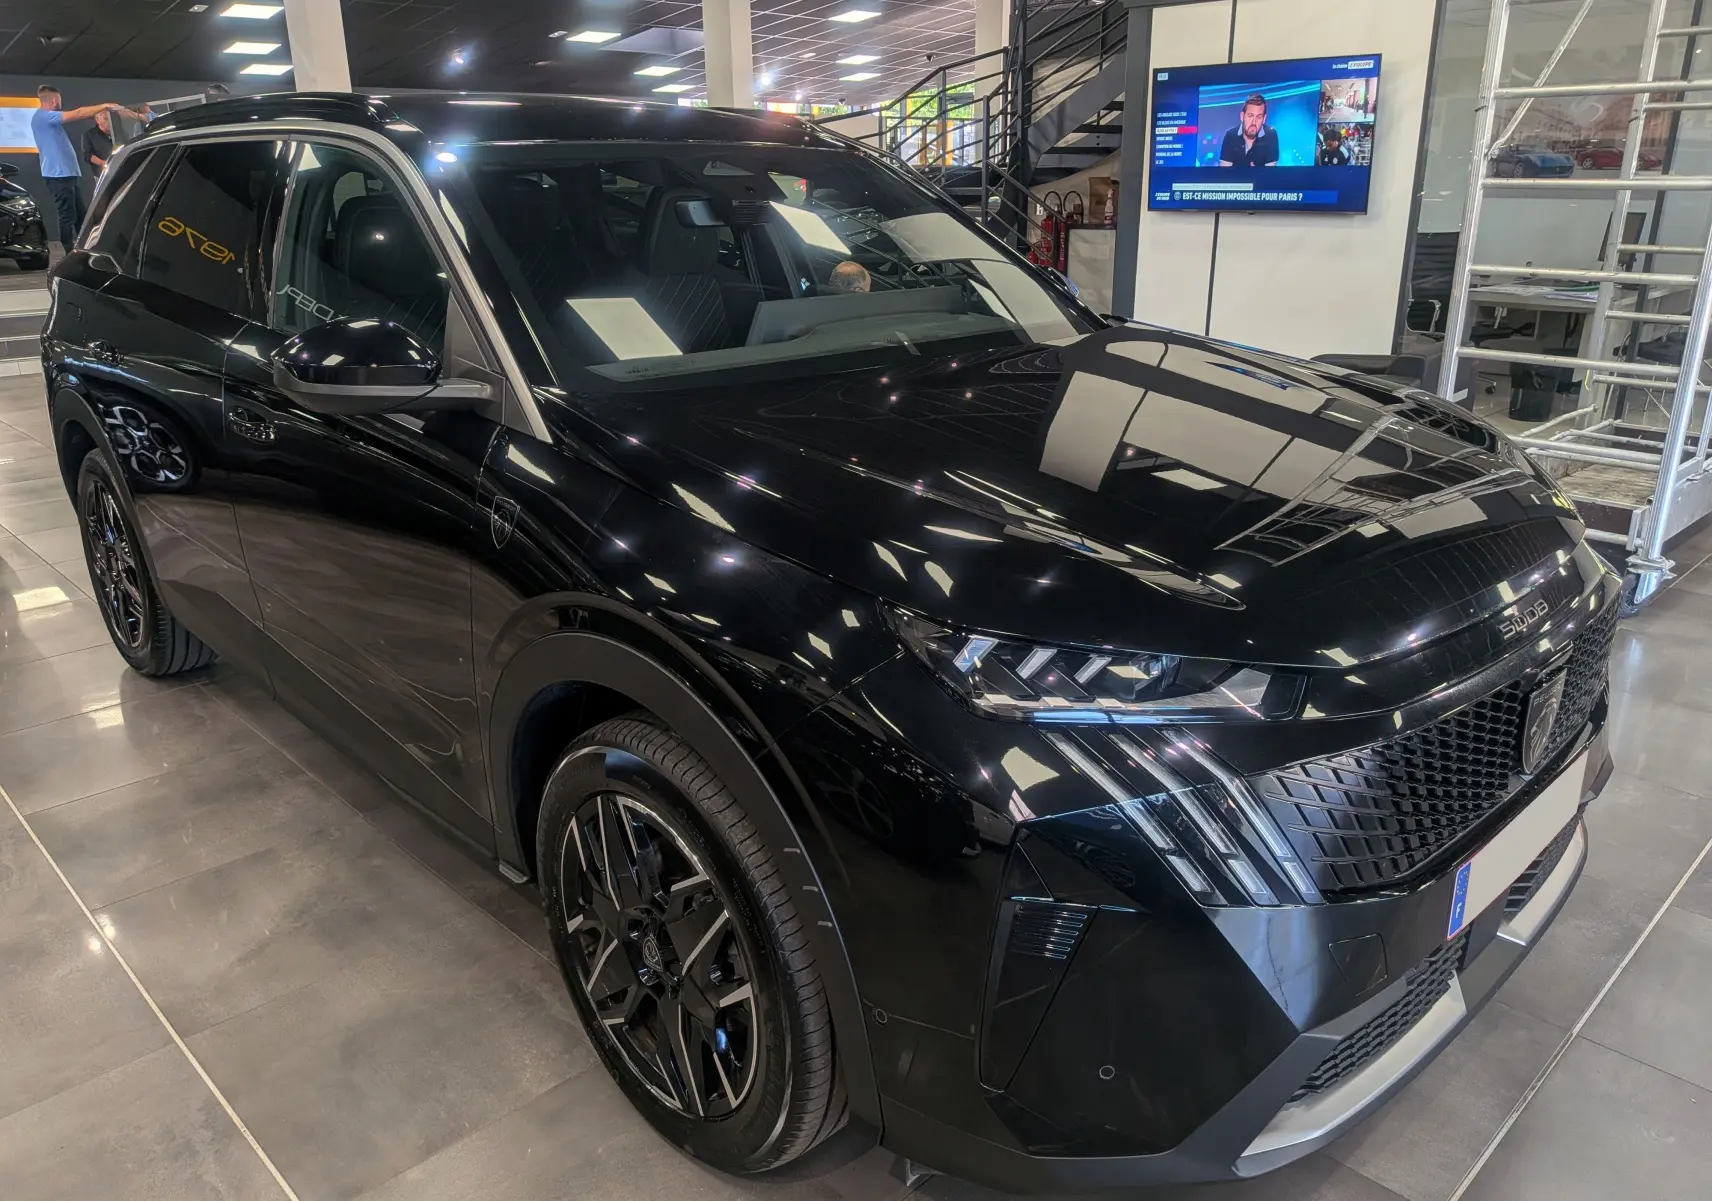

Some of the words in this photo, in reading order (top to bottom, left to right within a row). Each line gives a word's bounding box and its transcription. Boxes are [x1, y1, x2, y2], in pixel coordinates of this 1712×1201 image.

[1182, 192, 1201, 200] EST-CE
[1202, 192, 1226, 200] MISSION
[1226, 192, 1261, 201] IMPOSSIBLE
[1261, 192, 1278, 201] POUR
[1278, 192, 1298, 201] PARIS
[1298, 192, 1303, 201] ?
[1499, 598, 1549, 640] 5008
